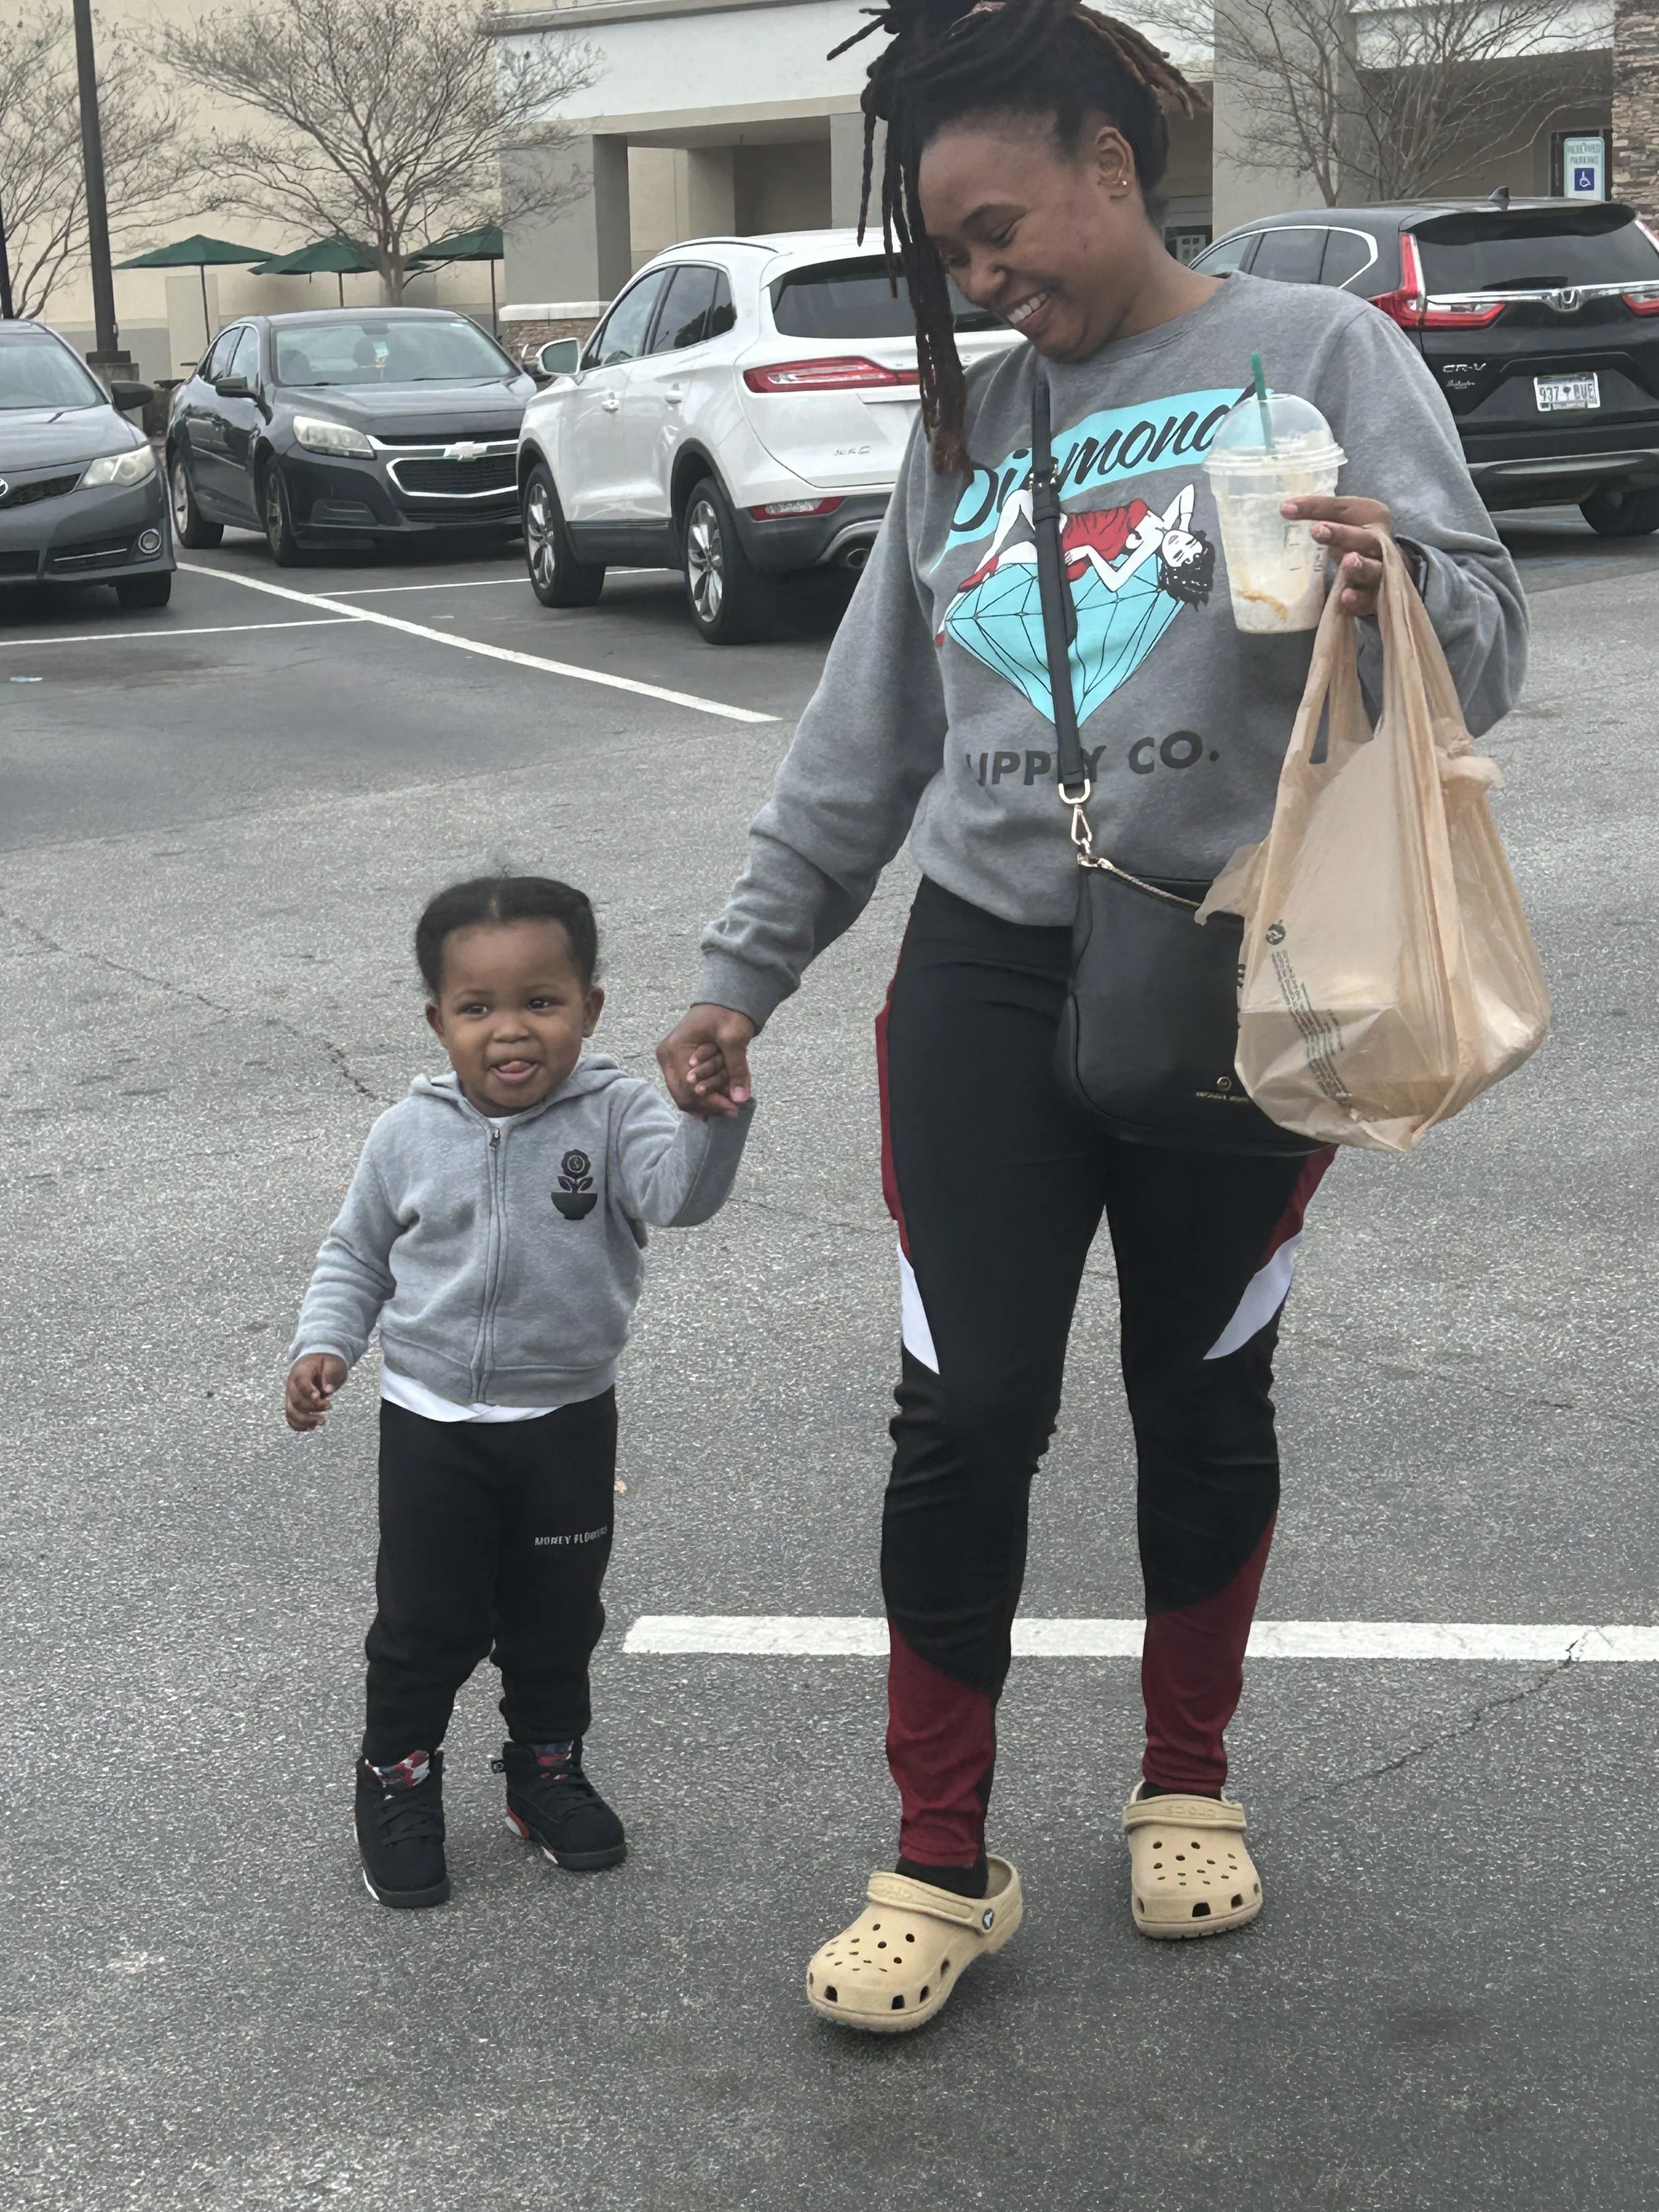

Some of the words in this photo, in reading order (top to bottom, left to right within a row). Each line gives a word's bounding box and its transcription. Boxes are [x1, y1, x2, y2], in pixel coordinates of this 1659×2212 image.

[1442, 362, 1486, 372] CR-V
[1538, 386, 1559, 402] 937
[950, 382, 1256, 532] Dimond
[1128, 730, 1220, 775] CO.
[534, 1535, 571, 1546] MONEY
